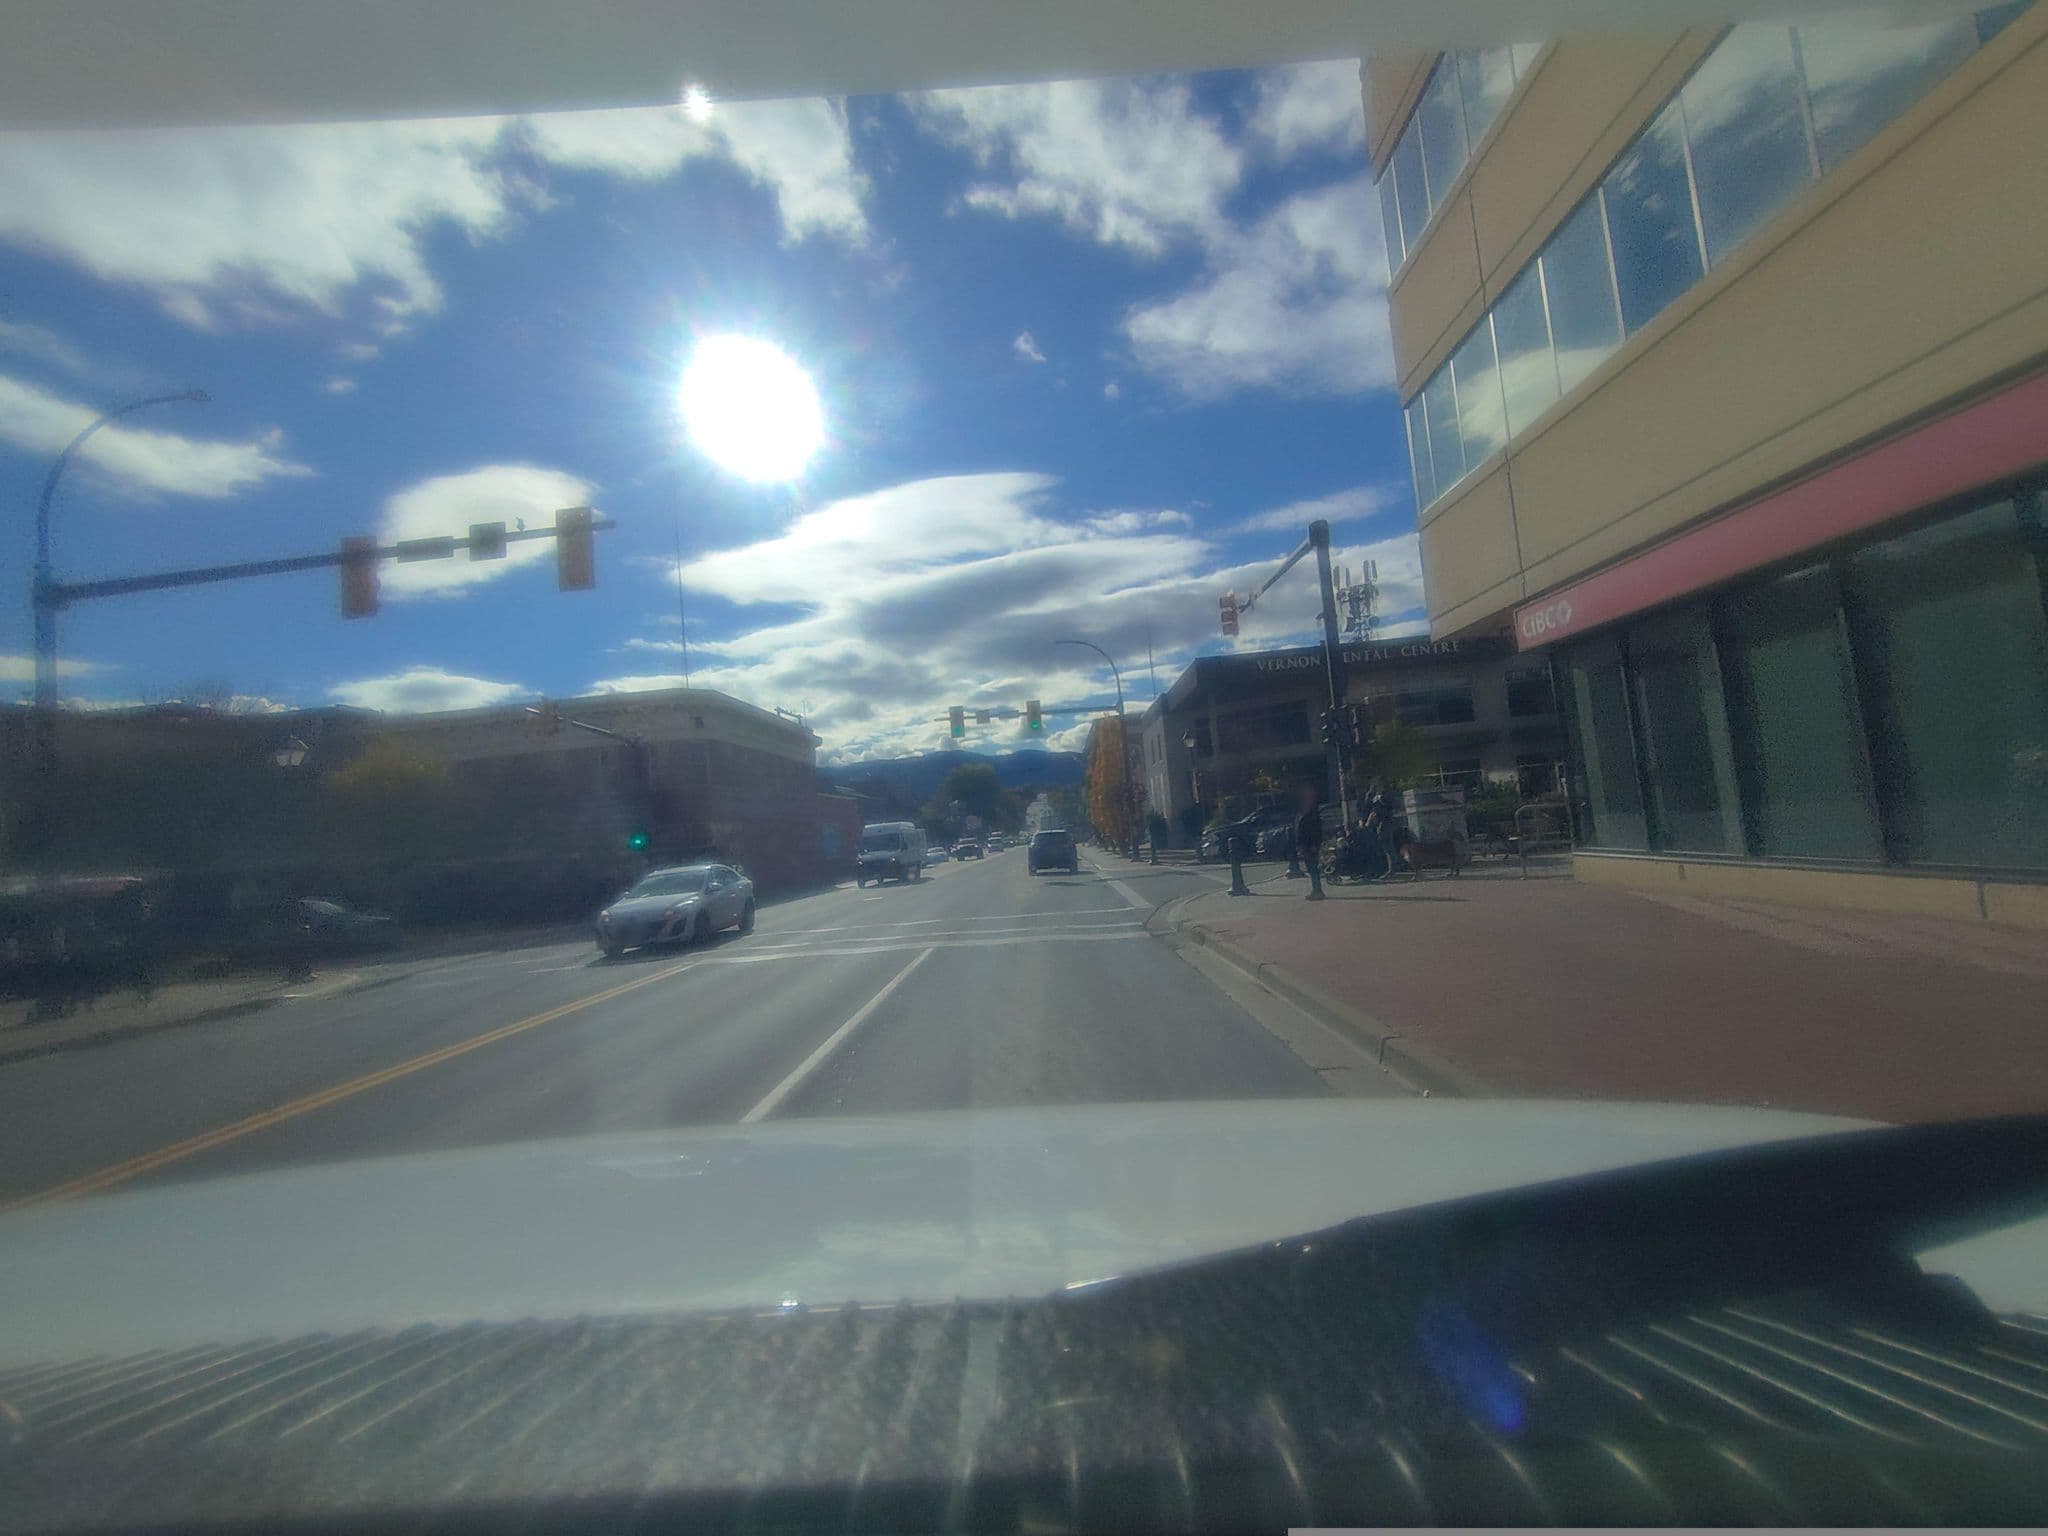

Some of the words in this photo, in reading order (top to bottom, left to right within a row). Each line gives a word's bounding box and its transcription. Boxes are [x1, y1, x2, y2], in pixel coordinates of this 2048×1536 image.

[1522, 605, 1558, 638] CIBC
[1257, 655, 1321, 671] VERNON
[1338, 647, 1392, 664] ENTAL
[1400, 640, 1460, 657] CENTRE
